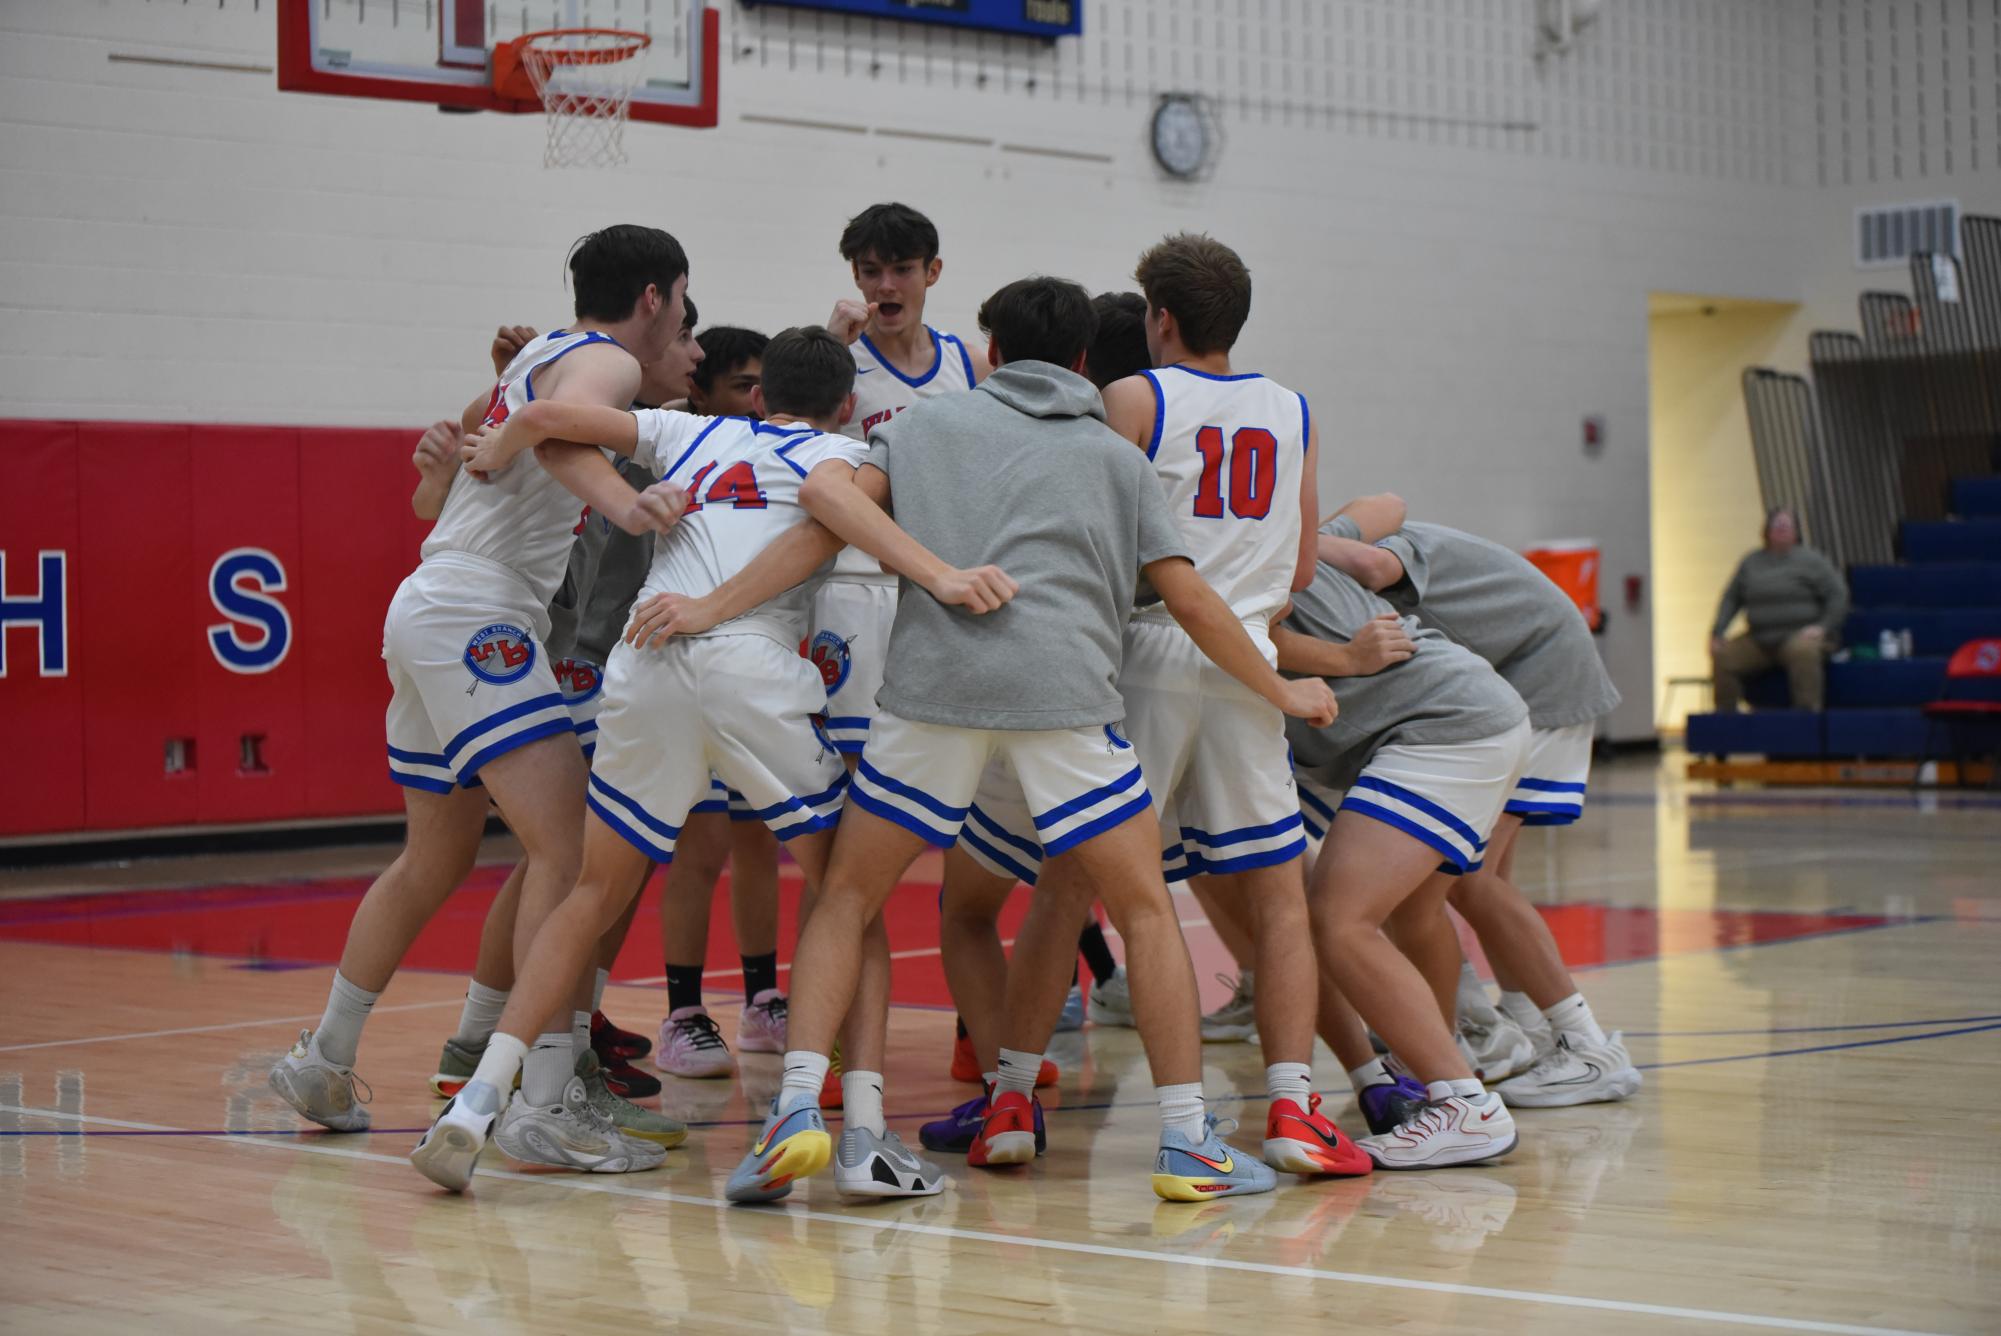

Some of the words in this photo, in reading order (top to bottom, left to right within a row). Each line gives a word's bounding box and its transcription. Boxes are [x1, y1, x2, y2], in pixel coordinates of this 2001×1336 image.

[680, 459, 768, 518] 14
[1193, 425, 1278, 521] 10
[0, 549, 68, 678] H
[207, 547, 293, 675] S
[471, 629, 490, 647] WEST
[491, 625, 523, 639] BRANCH
